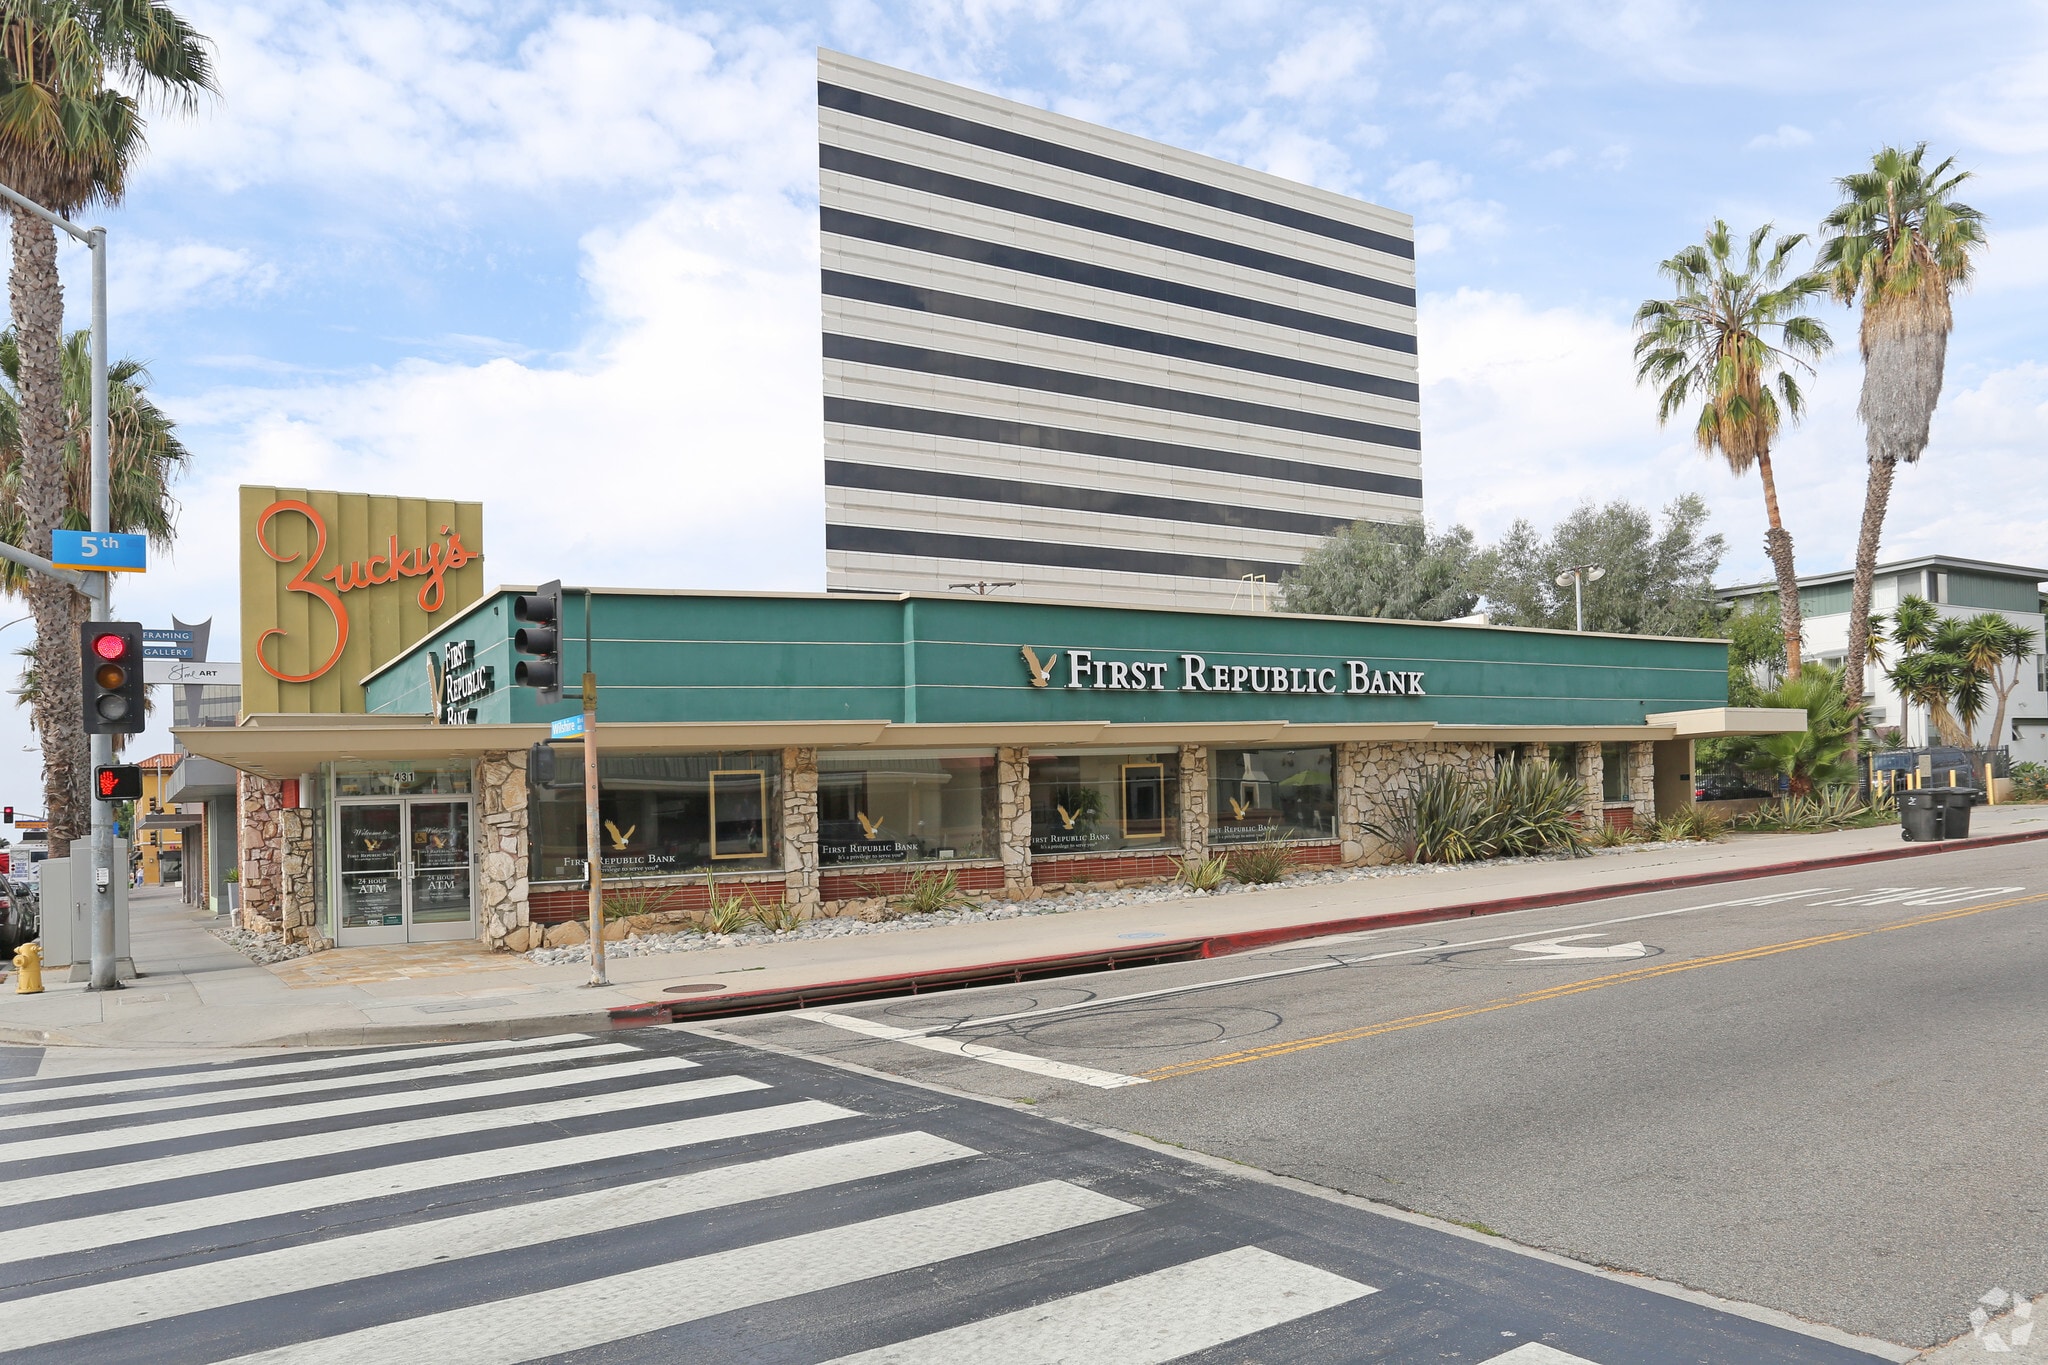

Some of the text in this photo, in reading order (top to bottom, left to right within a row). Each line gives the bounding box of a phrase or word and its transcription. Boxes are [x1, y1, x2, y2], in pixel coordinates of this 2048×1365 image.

[81, 536, 119, 558] 5th
[256, 499, 479, 683] Zucky's
[142, 631, 190, 640] FRAMING
[144, 648, 188, 656] GALLERY
[445, 640, 467, 673] FIRST
[1066, 650, 1426, 696] FIRST REPUBLIC BANK
[445, 665, 487, 704] REPUBLIC
[552, 719, 575, 735] Wilshire
[394, 772, 415, 782] 431
[1224, 825, 1256, 833] REPUBLIC
[1050, 834, 1088, 843] REPUBLIC
[1089, 833, 1110, 841] BANK
[822, 842, 918, 854] FIRST REPUBLIC BANK
[563, 857, 588, 867] FIRS
[648, 854, 676, 863] BANK
[359, 884, 387, 894] ATM
[428, 880, 455, 890] ATM
